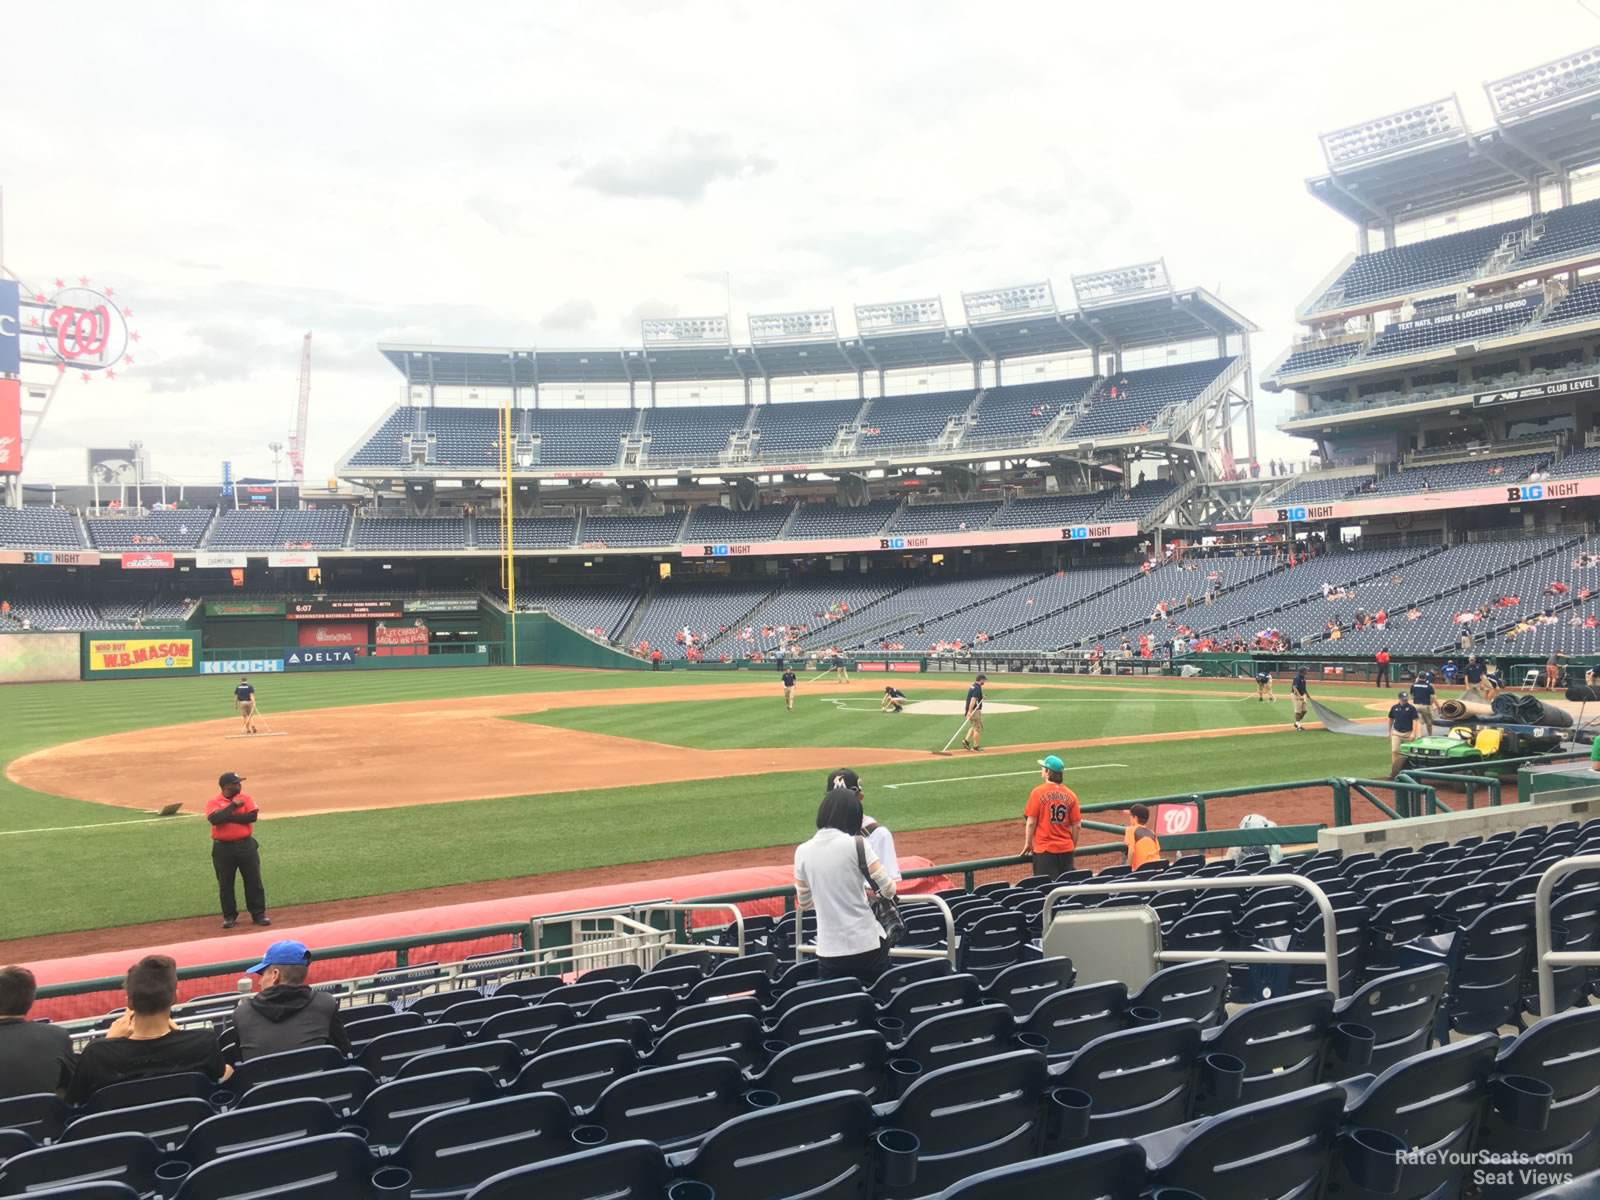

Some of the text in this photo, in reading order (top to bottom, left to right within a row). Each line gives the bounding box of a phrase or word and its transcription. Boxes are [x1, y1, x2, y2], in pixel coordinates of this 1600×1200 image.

[1398, 322, 1413, 330] TEXT
[1415, 319, 1433, 328] NATS,
[1434, 315, 1453, 324] ISSUE
[1462, 307, 1493, 319] LOCATION
[1504, 299, 1527, 310] 69050
[1547, 379, 1594, 394] CLUB LEVEL
[1547, 483, 1579, 496] NIGHT
[1308, 506, 1333, 518] NIGHT
[1089, 527, 1111, 536] NIGHT
[907, 538, 928, 547] NIGHT
[730, 546, 751, 554] NIGHT
[55, 554, 80, 563] NIGHT
[95, 643, 126, 652] WHO BUT
[304, 652, 352, 662] DELTA
[223, 660, 276, 673] KOCH
[1050, 803, 1067, 823] 16
